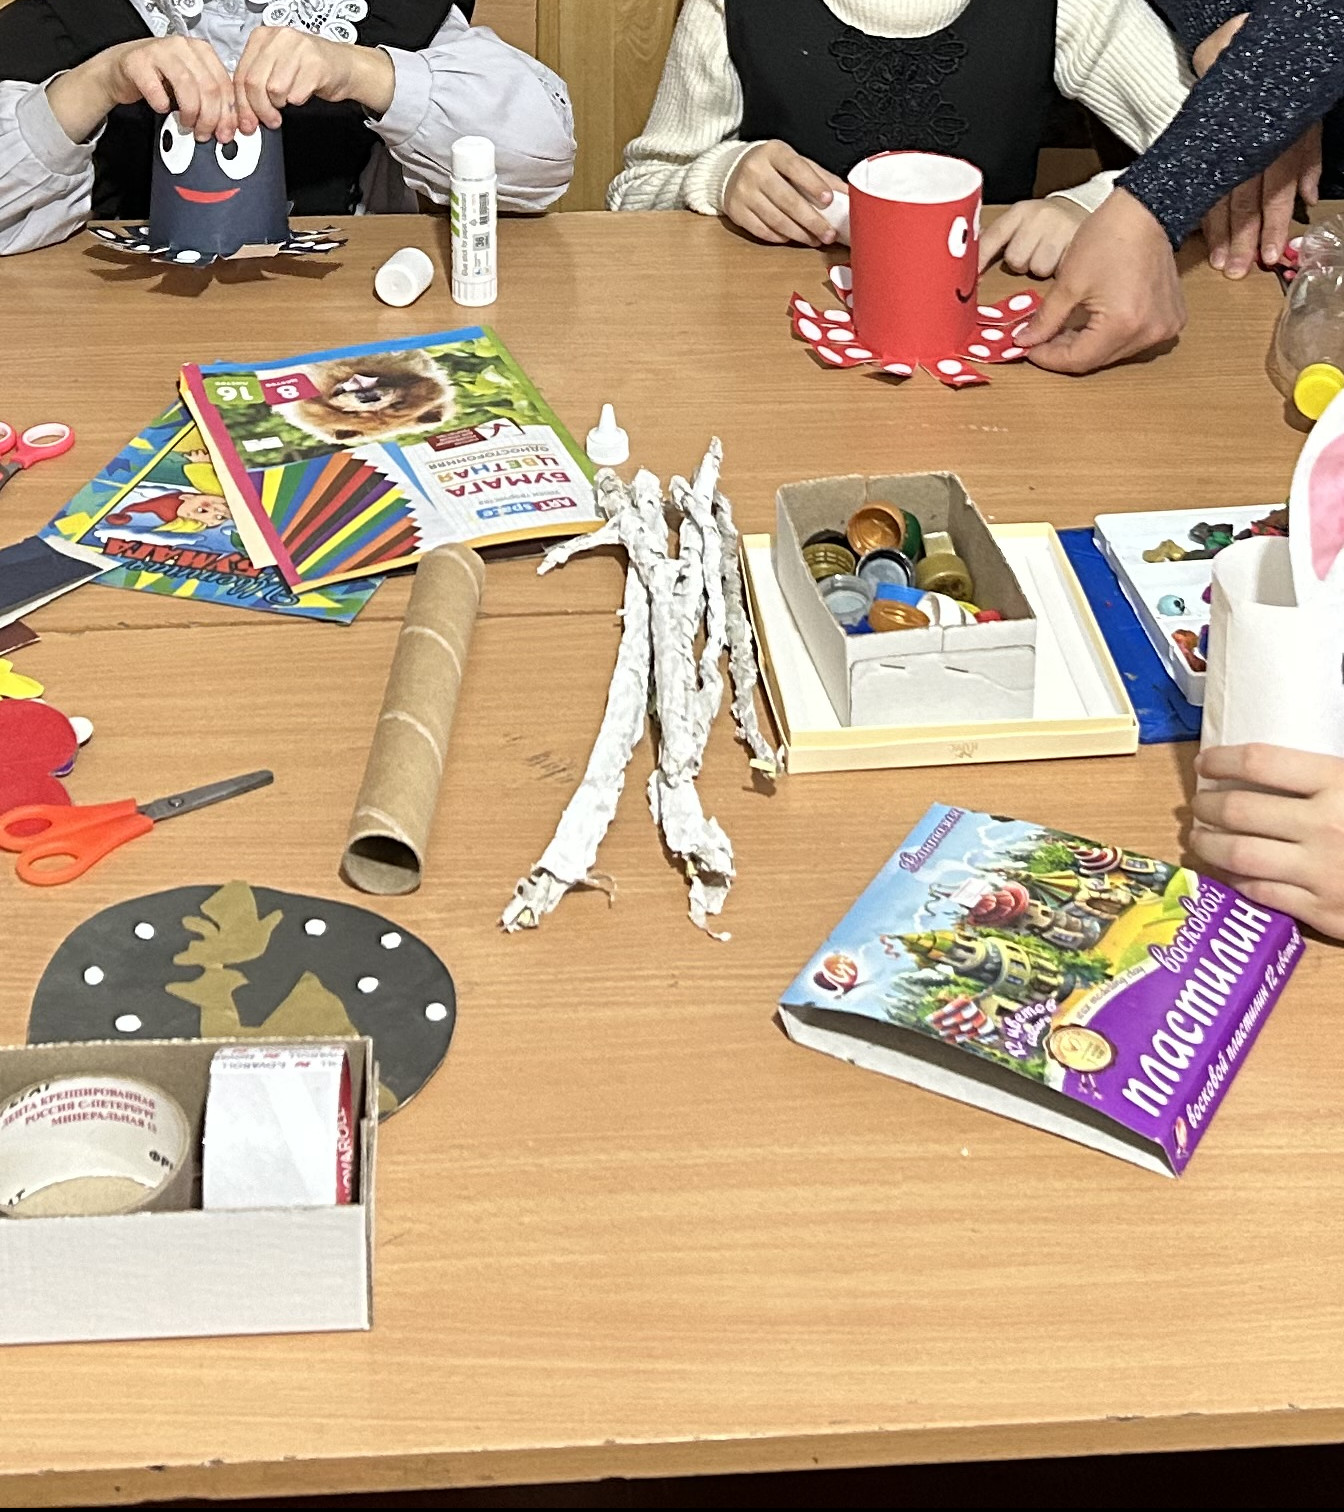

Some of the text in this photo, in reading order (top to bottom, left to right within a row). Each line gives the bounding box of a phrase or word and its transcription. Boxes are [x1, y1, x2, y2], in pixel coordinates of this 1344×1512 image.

[216, 386, 254, 401] 16
[276, 385, 300, 399] 8
[437, 454, 560, 484] ЦВЕТНАЯ
[444, 471, 572, 498] БУМАГА
[104, 537, 264, 577] БУМАГА
[1149, 883, 1226, 974] восковой
[1121, 898, 1273, 1118] пластилин
[1186, 1050, 1230, 1129] восковой
[1227, 984, 1270, 1064] пластилин
[1265, 965, 1281, 988] 12
[24, 1101, 76, 1125] РОССИЯ
